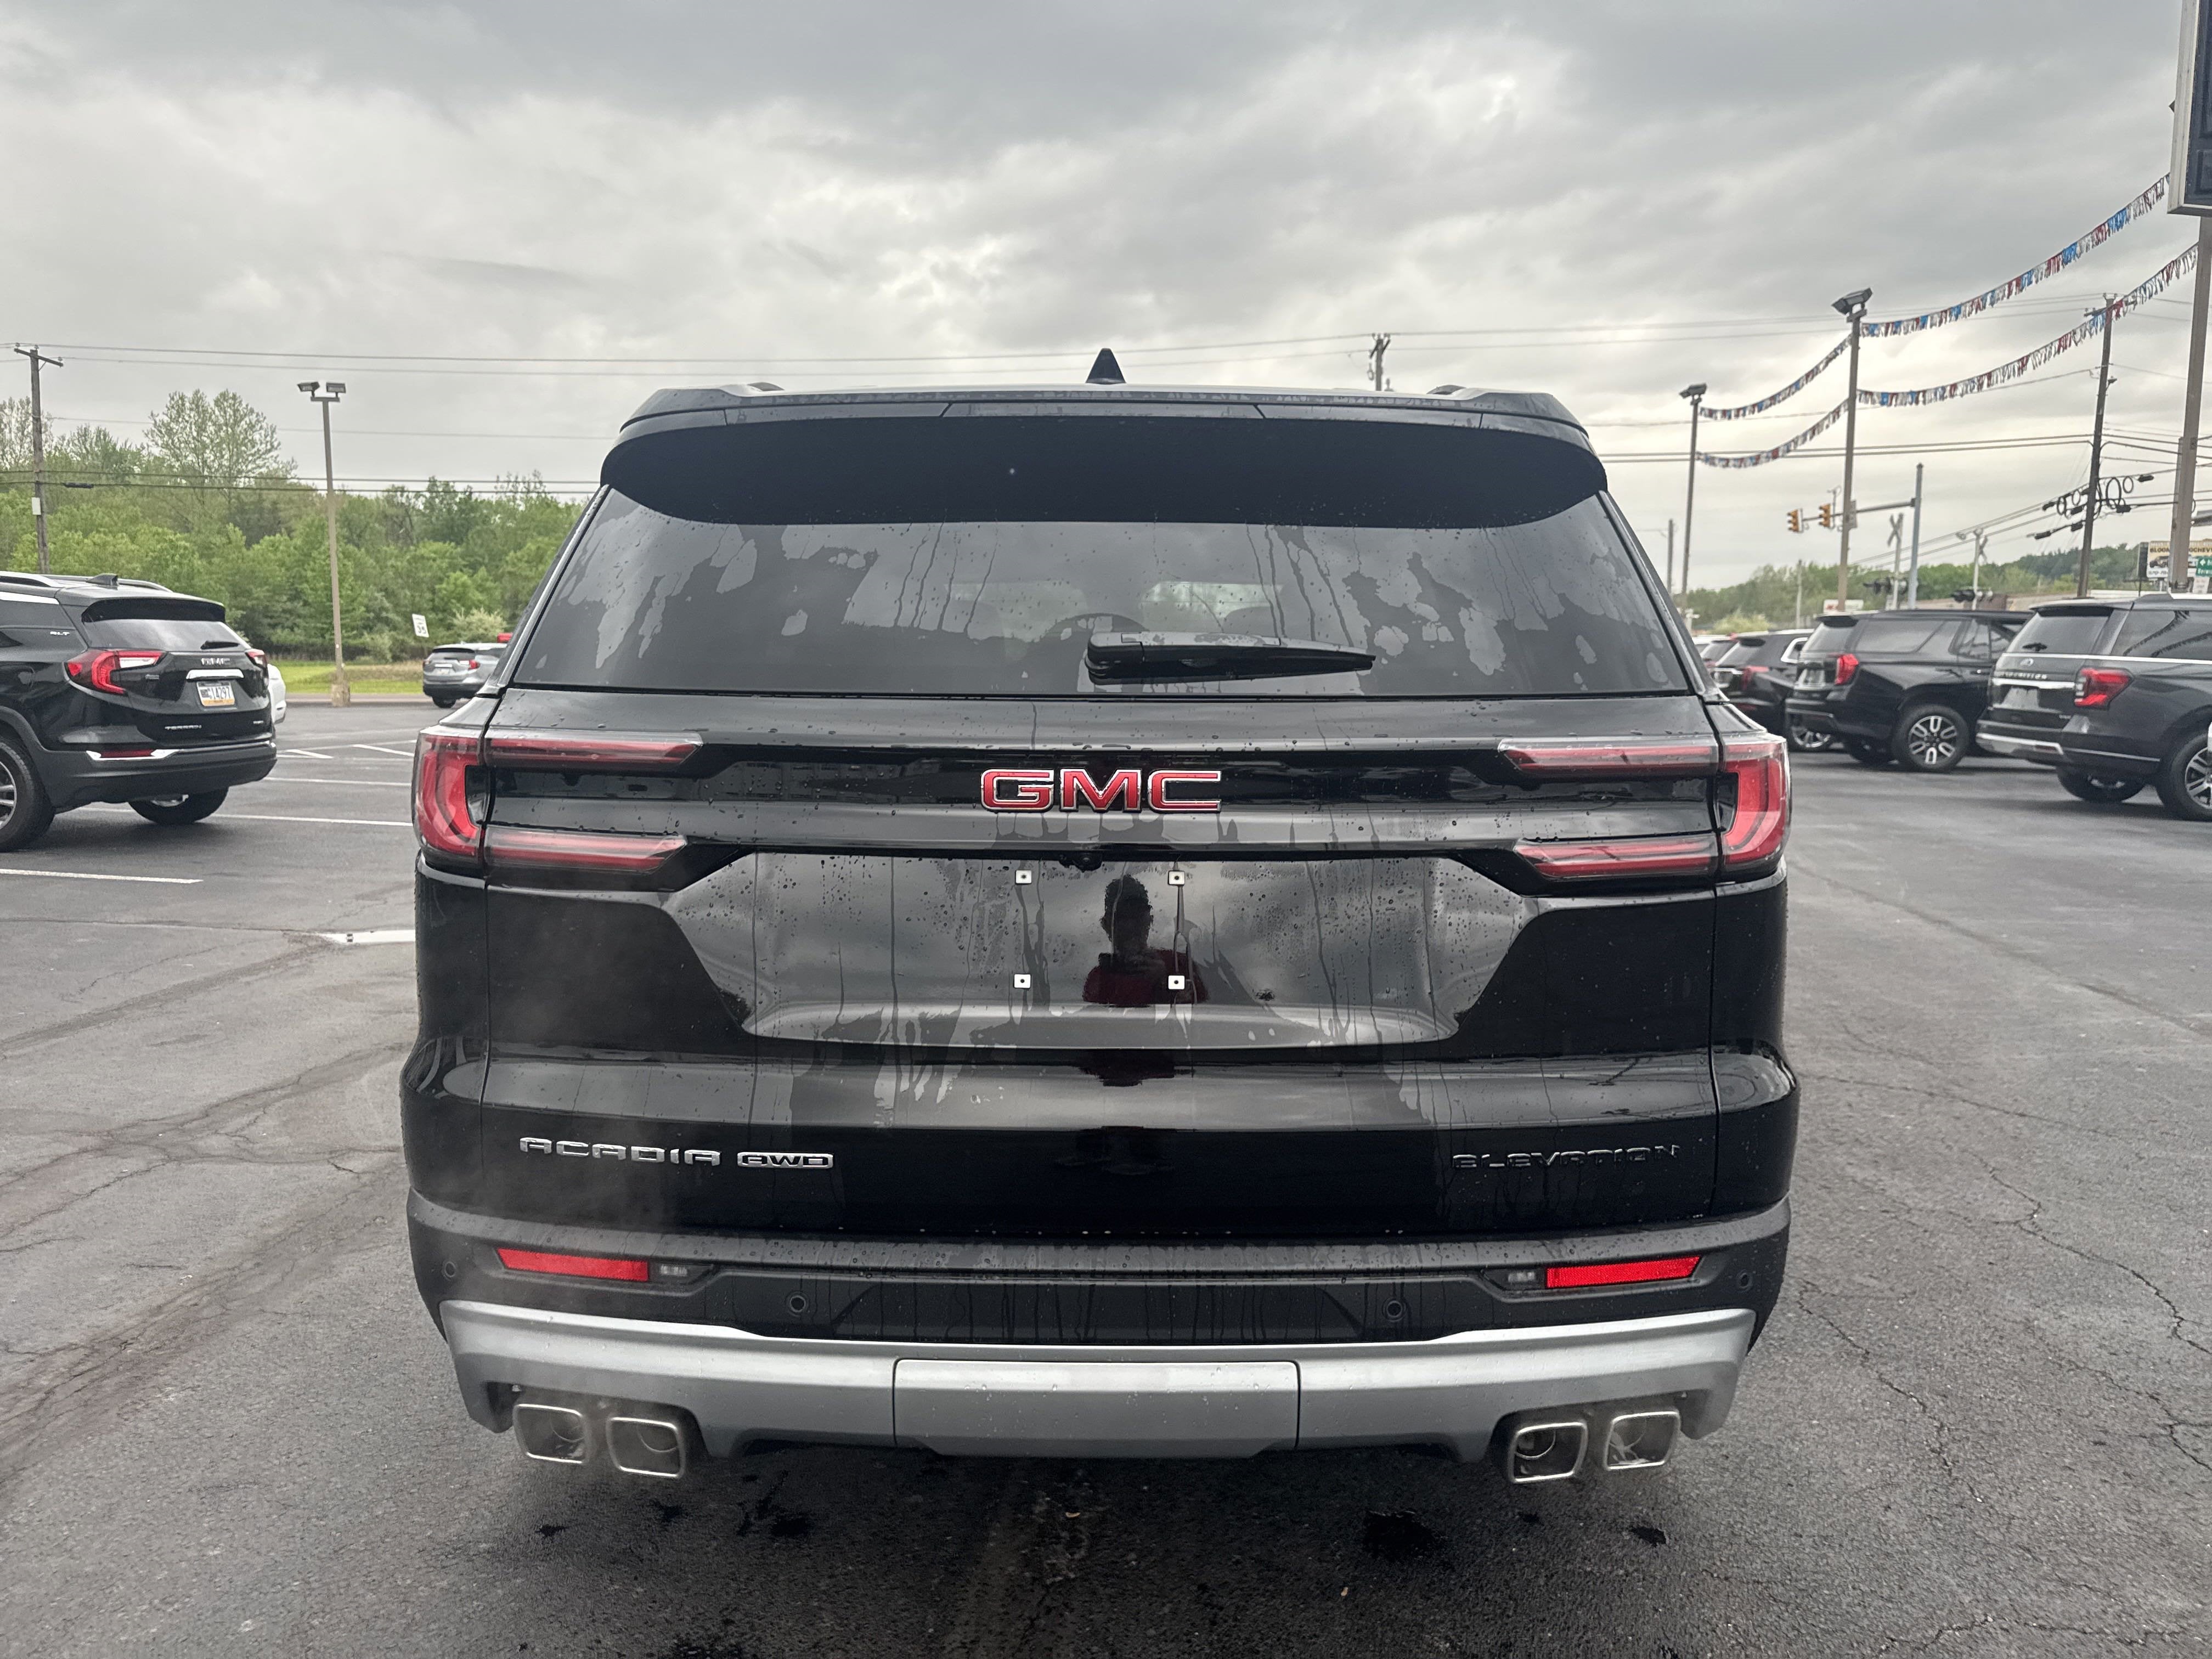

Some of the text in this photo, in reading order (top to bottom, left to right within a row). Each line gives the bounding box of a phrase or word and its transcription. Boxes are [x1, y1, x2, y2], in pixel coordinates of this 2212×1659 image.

[980, 768, 1222, 812] GMC
[519, 1137, 831, 1167] ACADIA AWD
[1452, 1144, 1680, 1167] ELEVATION
